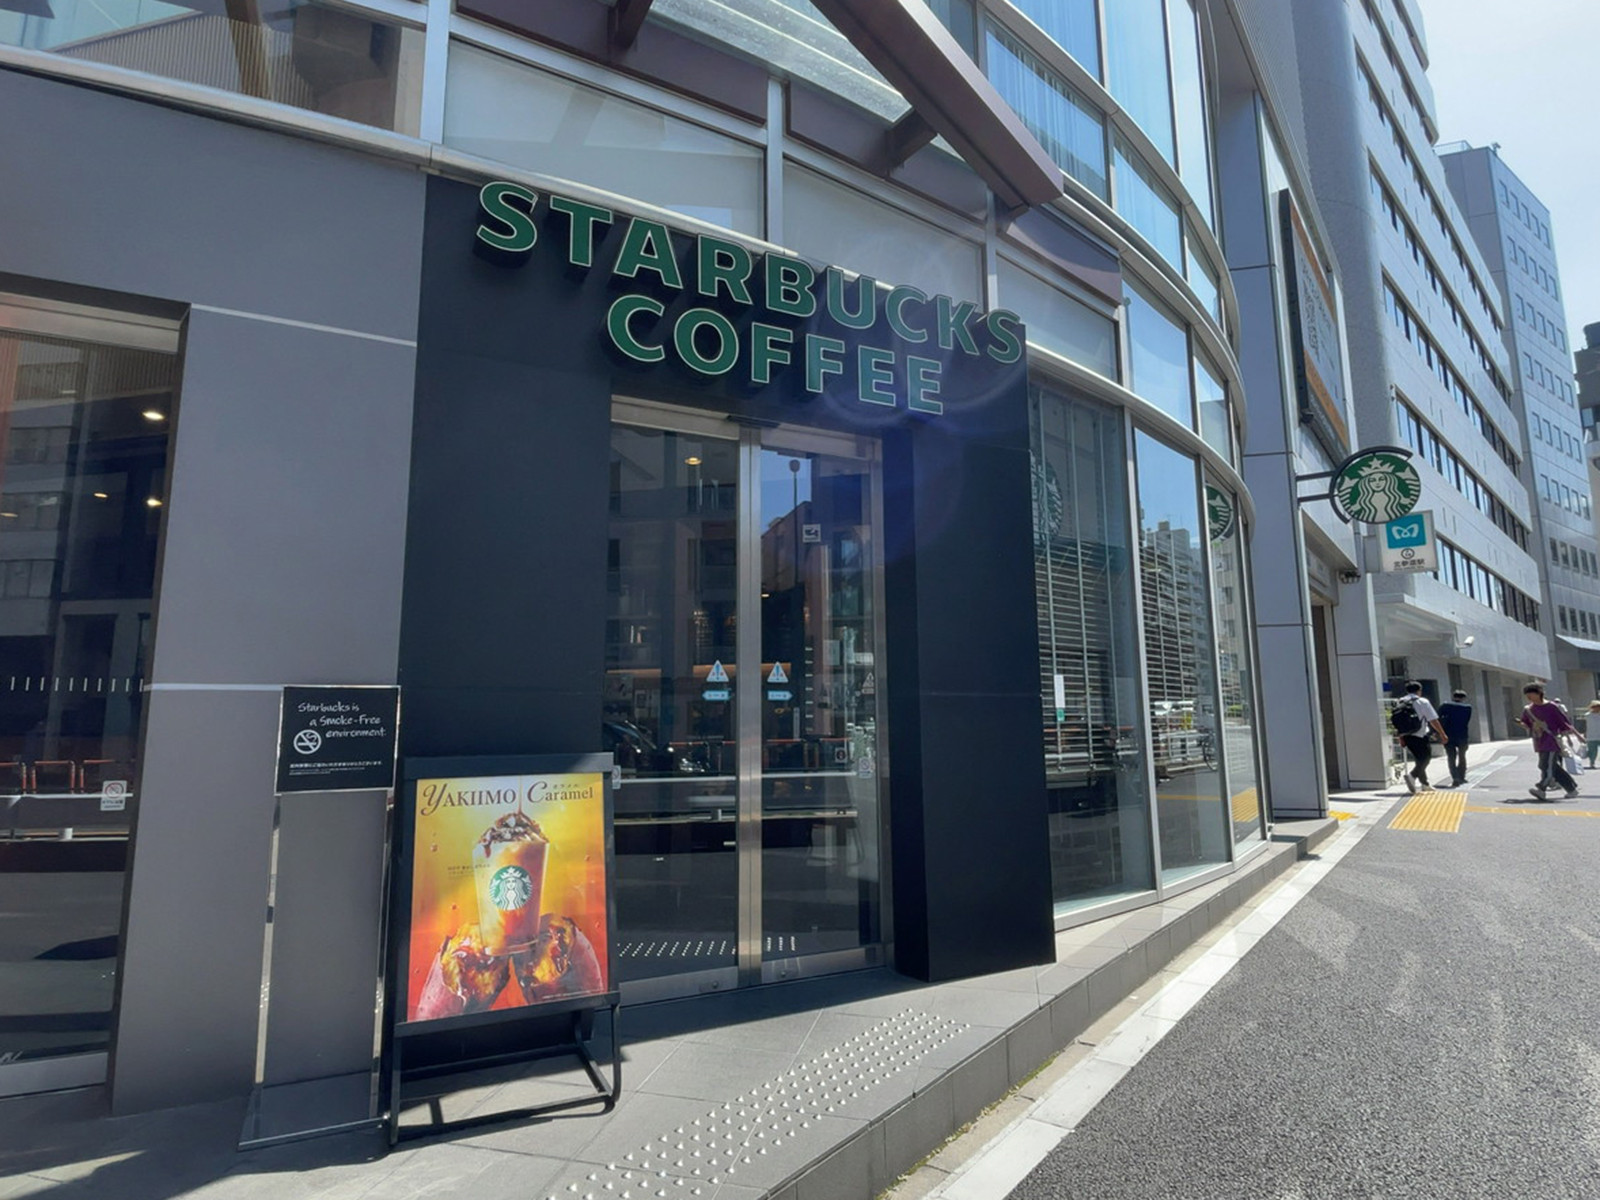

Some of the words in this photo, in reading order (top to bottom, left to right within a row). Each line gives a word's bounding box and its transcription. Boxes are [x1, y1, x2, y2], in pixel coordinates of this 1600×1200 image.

[476, 180, 1023, 364] STARBUCKS
[606, 293, 944, 416] COFFEE
[297, 701, 351, 713] Starbucks
[351, 702, 360, 712] is
[309, 719, 318, 727] a
[420, 783, 517, 816] YAKIIMO
[527, 781, 593, 804] Caramel
